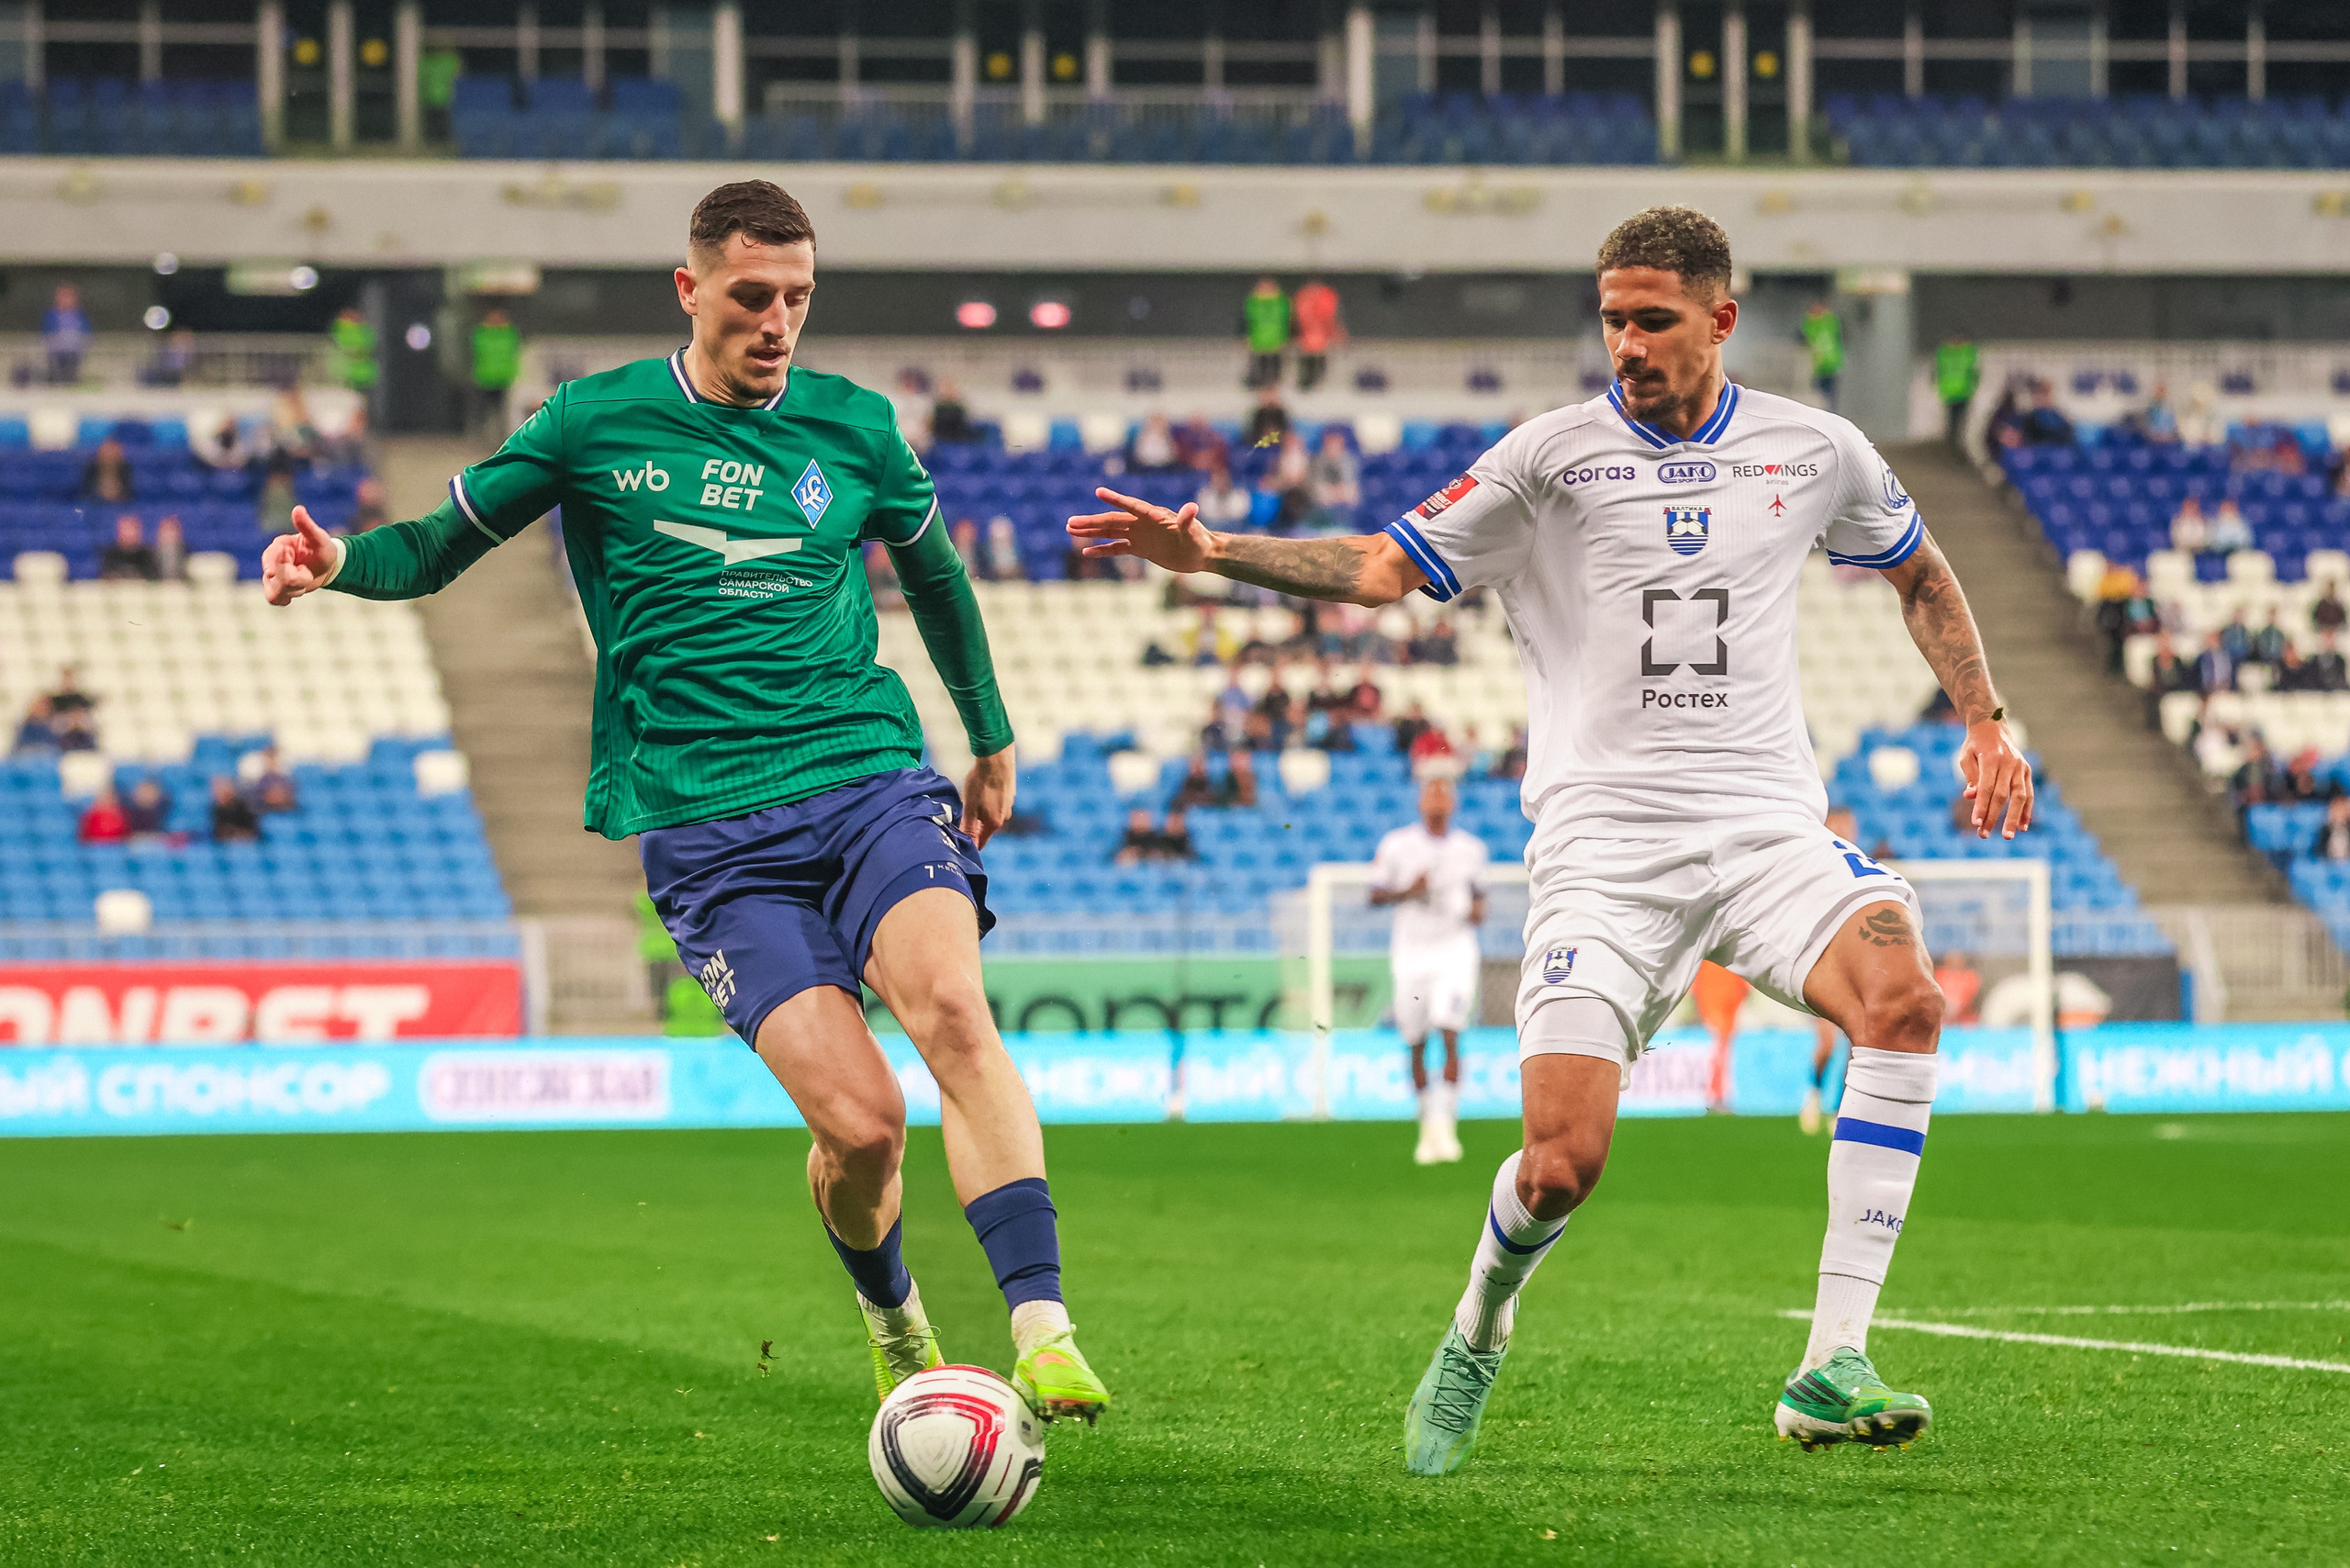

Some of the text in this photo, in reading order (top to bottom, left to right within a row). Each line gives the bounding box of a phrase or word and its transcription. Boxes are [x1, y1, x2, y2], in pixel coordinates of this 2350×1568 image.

[612, 460, 670, 492] wb
[700, 458, 766, 487] FON
[1664, 465, 1711, 479] JAKO
[699, 484, 764, 511] BET
[719, 577, 789, 594] САМАРСКОЙ
[721, 570, 813, 588] ПРАВИТЕЛЬСТВО
[718, 588, 774, 599] ОБЛАСТИ
[1641, 689, 1729, 709] Ростех
